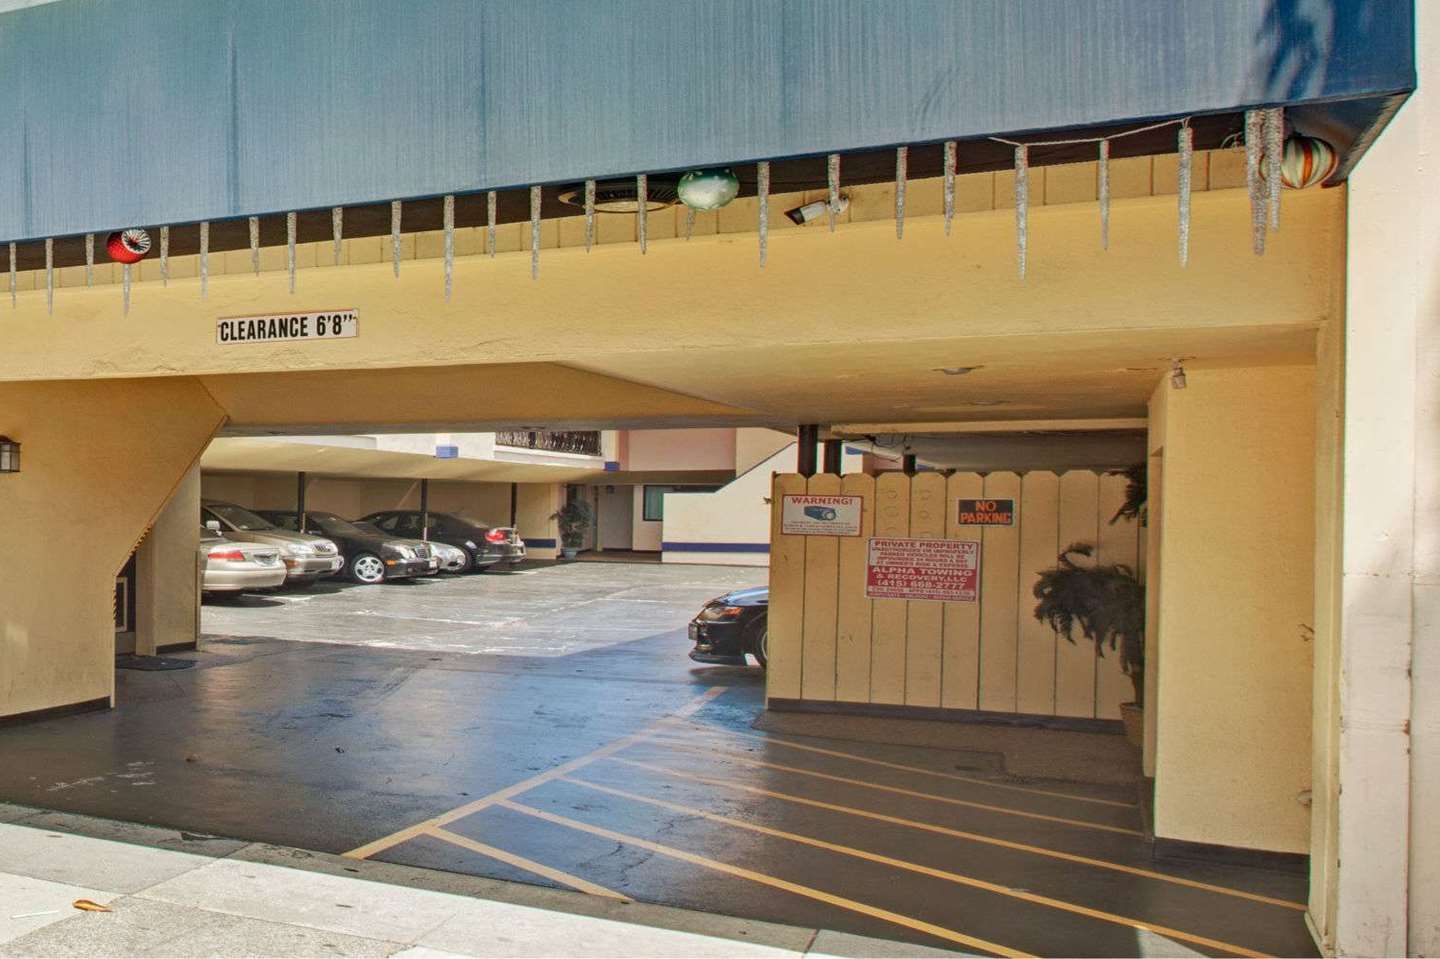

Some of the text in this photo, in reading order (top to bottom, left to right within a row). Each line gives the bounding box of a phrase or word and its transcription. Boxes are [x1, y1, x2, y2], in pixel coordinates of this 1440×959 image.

[220, 317, 308, 341] CLEARANCE
[791, 497, 853, 505] WARNING!
[975, 500, 997, 512] NO
[960, 512, 1012, 524] PARKING
[919, 542, 973, 550] PROPERTY
[872, 567, 973, 577] ALPHA TOWING
